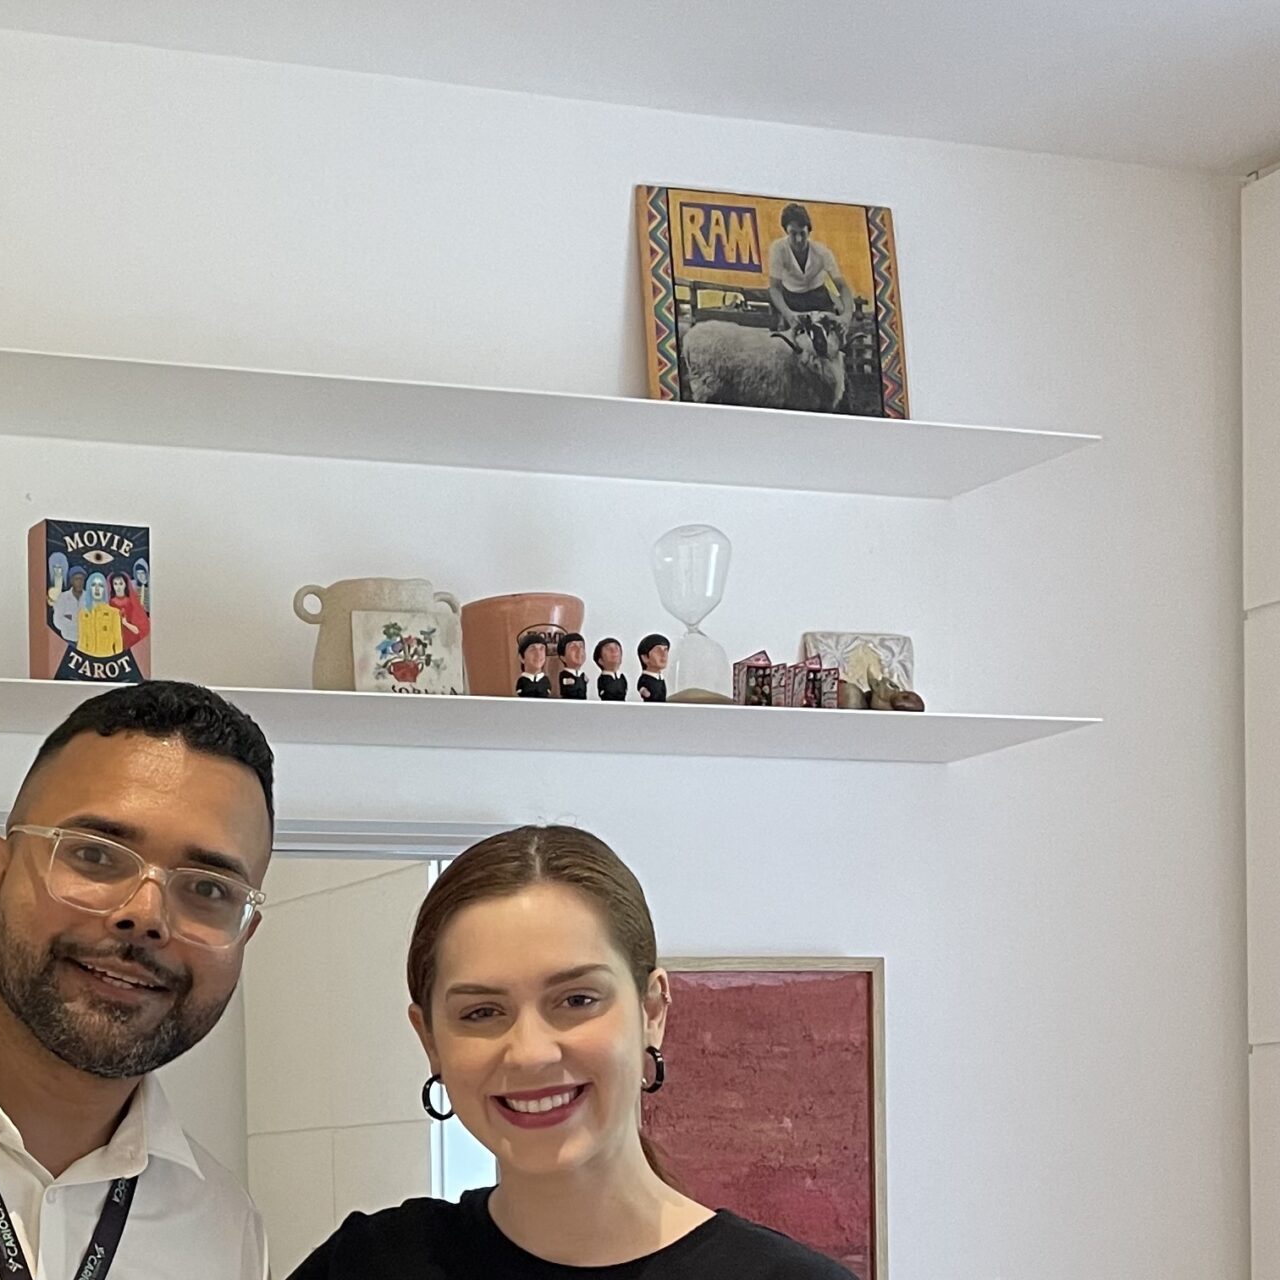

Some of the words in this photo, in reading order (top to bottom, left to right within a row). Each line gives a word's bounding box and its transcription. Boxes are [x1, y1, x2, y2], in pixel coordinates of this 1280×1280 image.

[681, 206, 760, 266] RAM
[63, 530, 134, 558] MOVIE
[68, 651, 132, 679] TAROT
